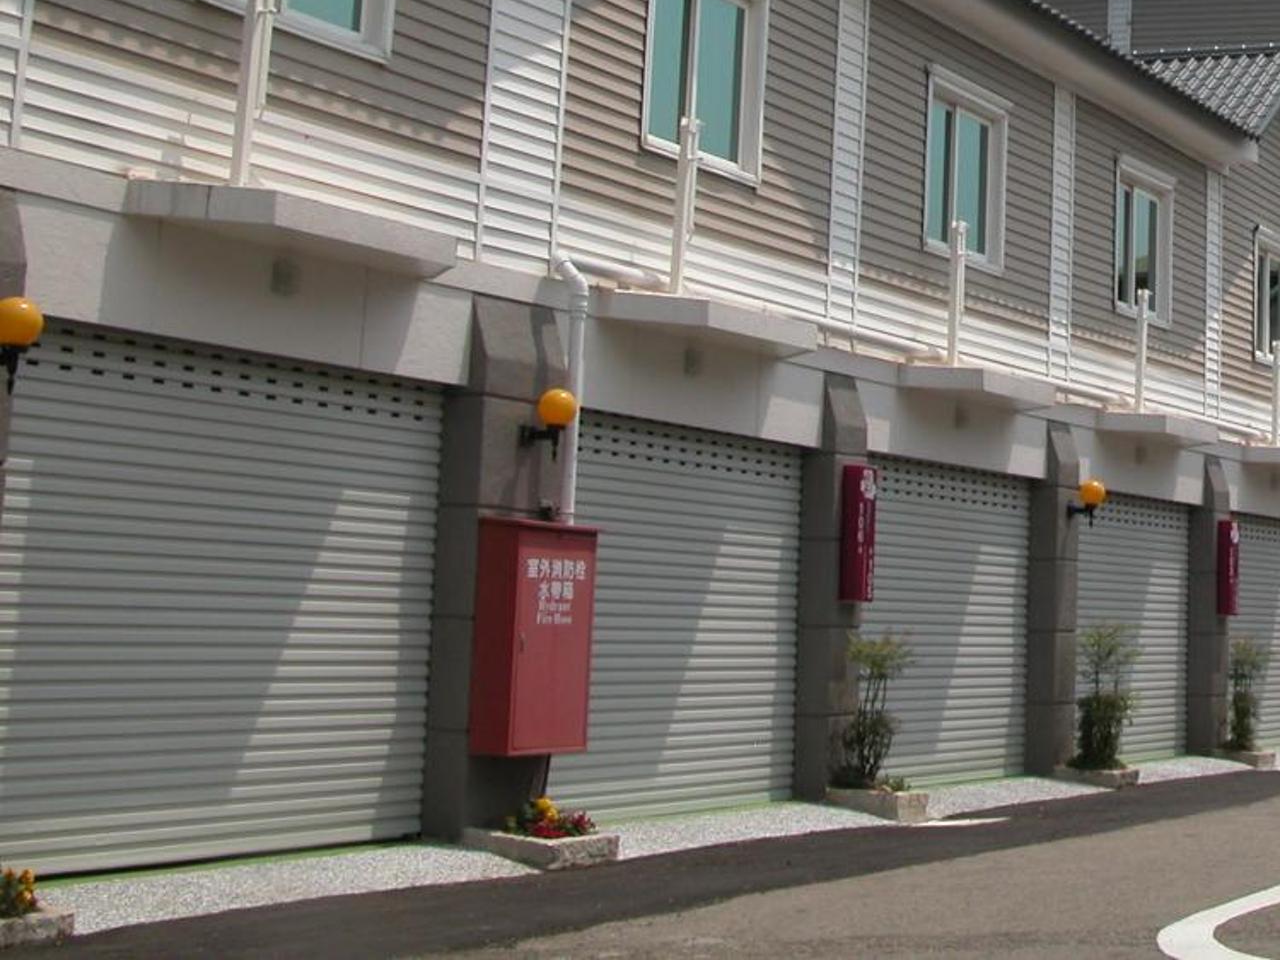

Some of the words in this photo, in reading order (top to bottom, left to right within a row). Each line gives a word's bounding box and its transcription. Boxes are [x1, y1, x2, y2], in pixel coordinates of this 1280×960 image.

[527, 558, 586, 580] 室外消防栓
